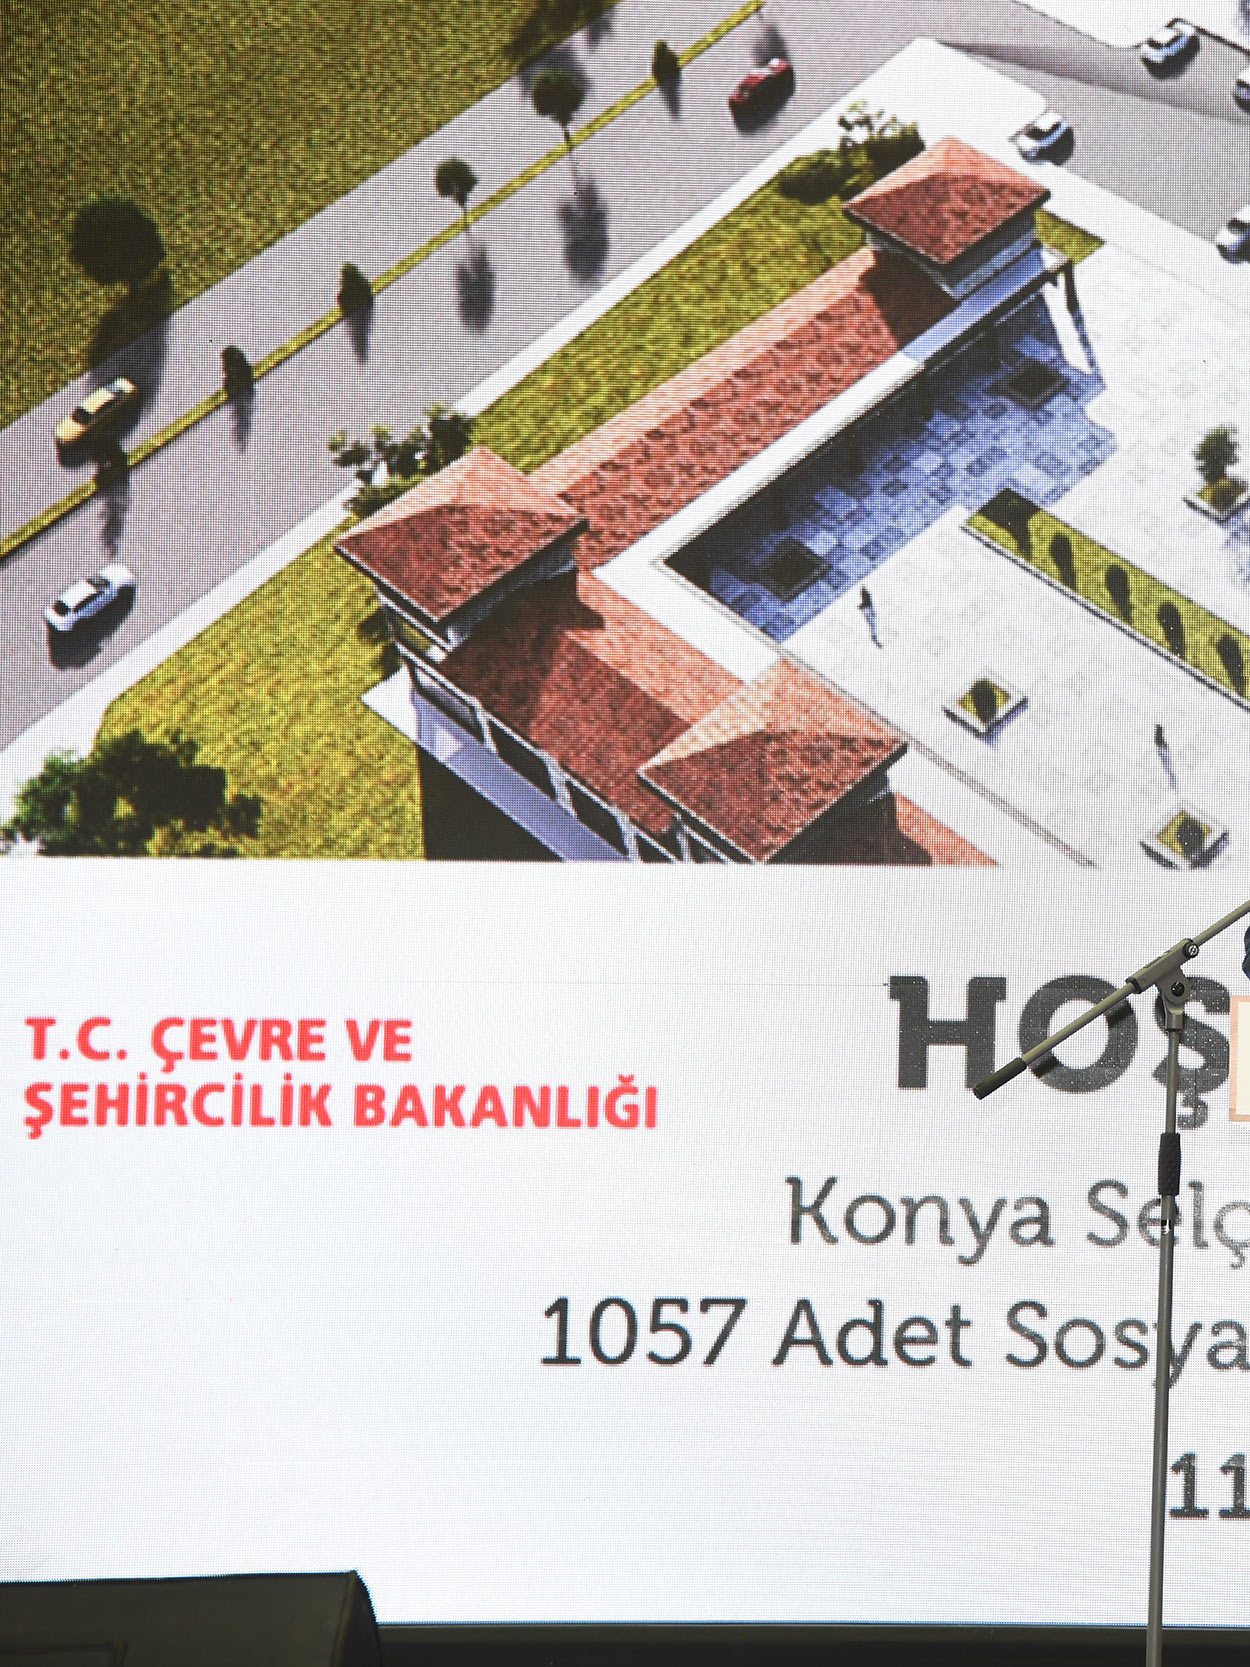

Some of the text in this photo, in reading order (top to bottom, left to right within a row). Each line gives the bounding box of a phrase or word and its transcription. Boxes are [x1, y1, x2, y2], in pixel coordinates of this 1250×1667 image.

[24, 1017, 413, 1071] T.C. ÇEVRE VE
[889, 975, 1230, 1130] HOŞ
[23, 1072, 659, 1140] ŞEHİRCİLİK BAKANLIĞI
[785, 1175, 1055, 1266] Konya
[540, 1296, 748, 1367] 1057
[771, 1297, 973, 1369] Adet
